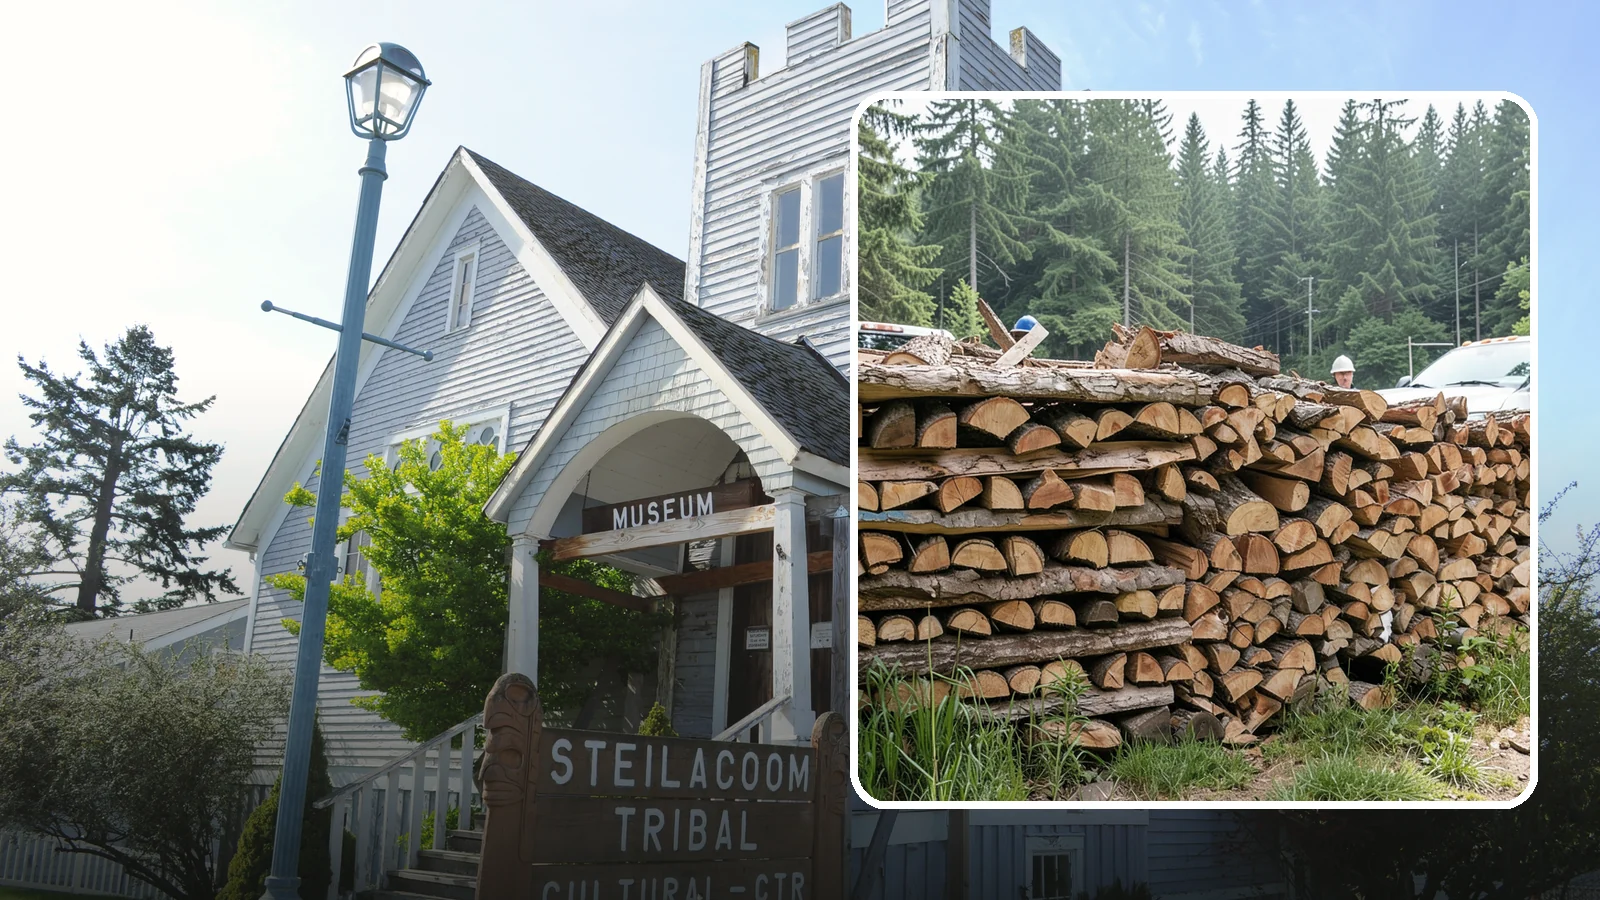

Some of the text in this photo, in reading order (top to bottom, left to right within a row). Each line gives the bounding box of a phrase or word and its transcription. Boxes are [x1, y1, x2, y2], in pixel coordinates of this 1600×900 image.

[612, 491, 714, 531] MUSEUM
[550, 738, 809, 792] STEILACOOM
[614, 806, 758, 852] TRIBAL
